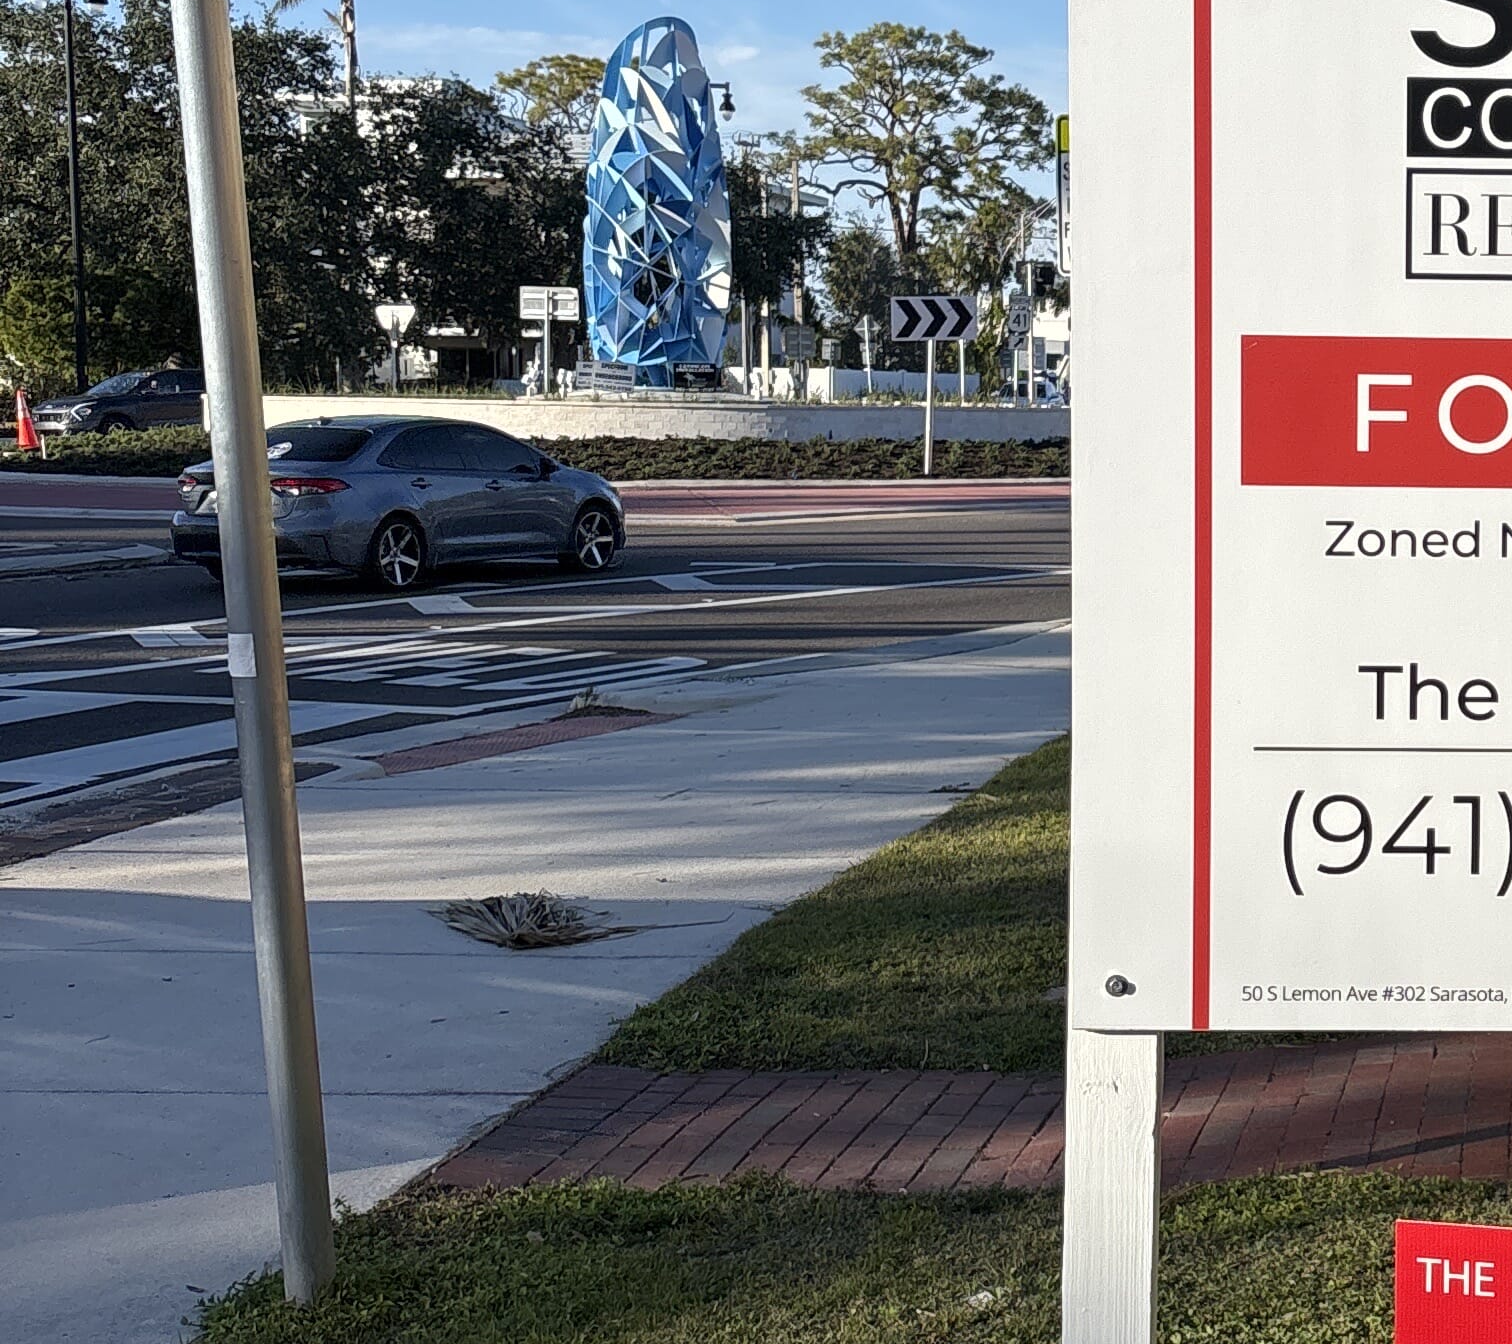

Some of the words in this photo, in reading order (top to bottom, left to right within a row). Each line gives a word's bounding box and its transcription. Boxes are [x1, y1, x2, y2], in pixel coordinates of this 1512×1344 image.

[1012, 313, 1027, 328] 41
[1325, 520, 1481, 559] Zoned
[195, 640, 708, 692] YIELD
[1358, 662, 1500, 722] The
[1242, 985, 1263, 1002] 50
[1267, 985, 1278, 1002] S
[1282, 986, 1342, 1002] Lemon
[1346, 986, 1378, 1002] Ave
[1382, 986, 1426, 1002] #302
[1430, 986, 1508, 1004] Sarasota,
[1416, 1257, 1495, 1298] THE
